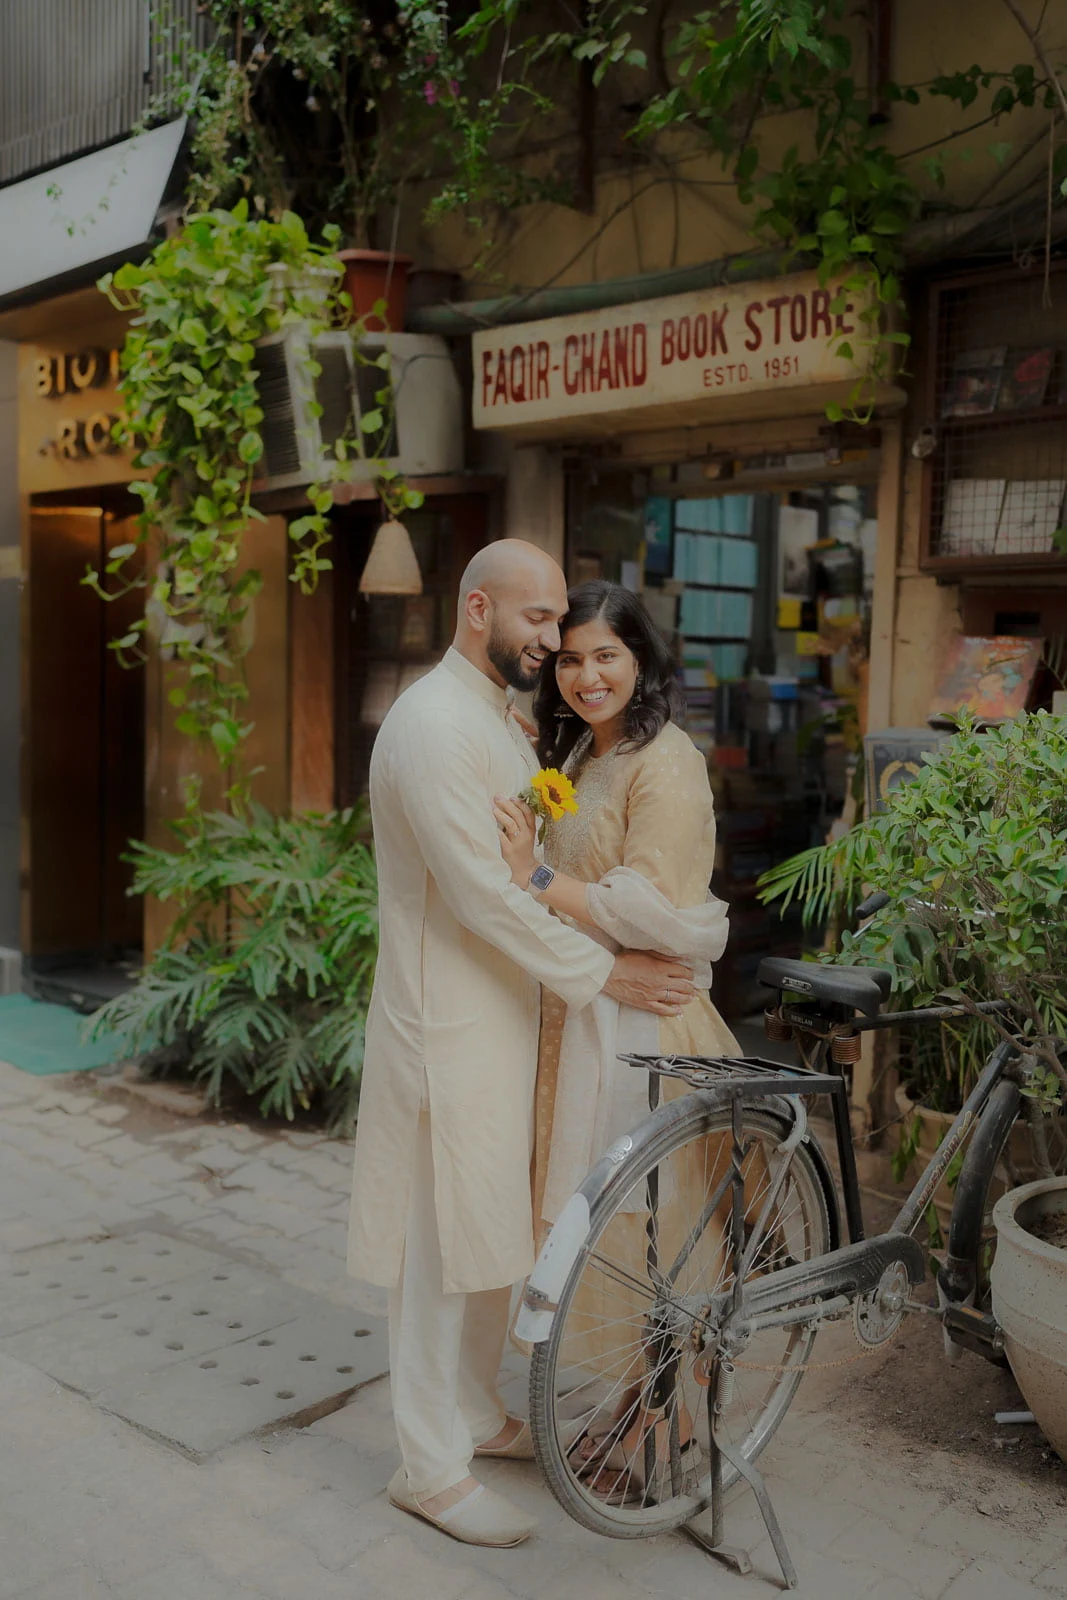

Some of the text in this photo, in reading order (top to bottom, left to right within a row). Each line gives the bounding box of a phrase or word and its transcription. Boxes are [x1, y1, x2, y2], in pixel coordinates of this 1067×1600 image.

[482, 286, 854, 407] FAQIR-CHAND BOOK STORE
[703, 356, 799, 387] ESTD. 1951
